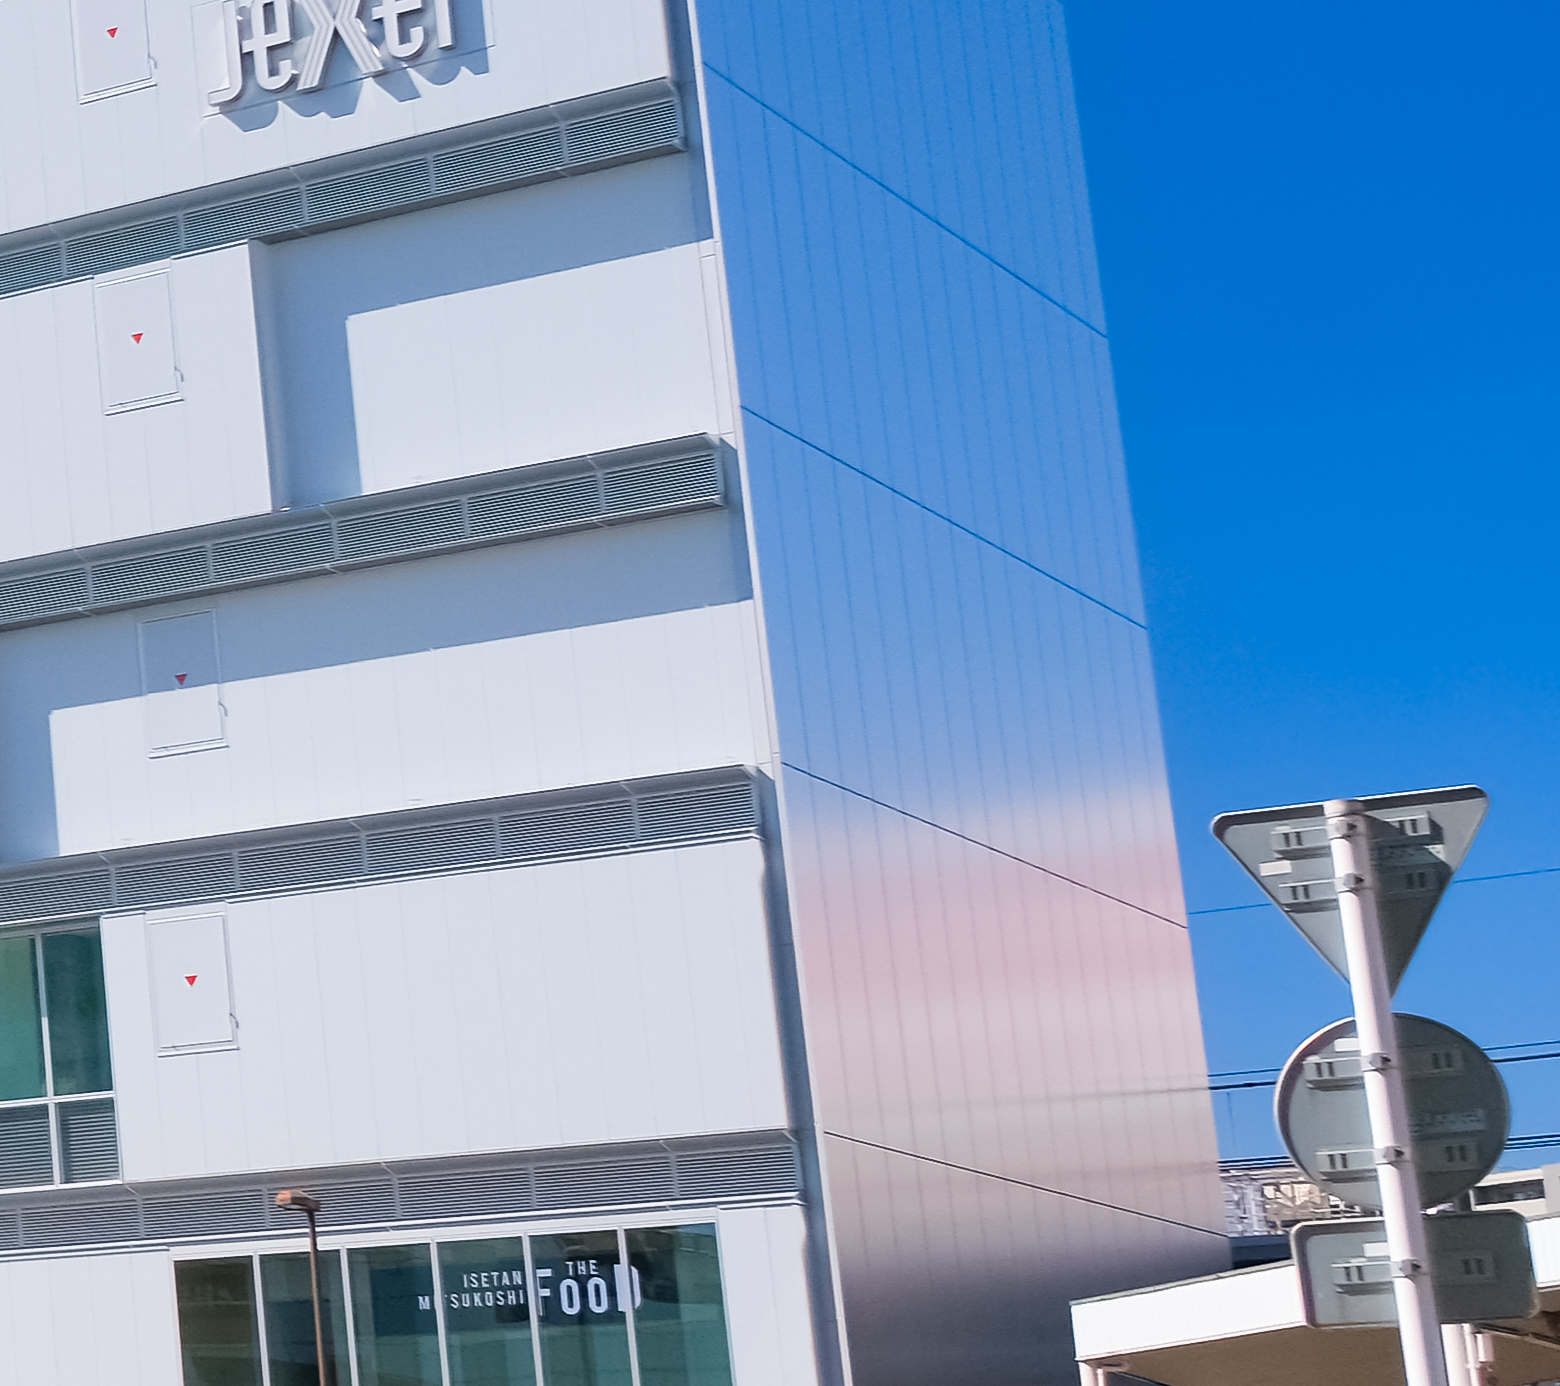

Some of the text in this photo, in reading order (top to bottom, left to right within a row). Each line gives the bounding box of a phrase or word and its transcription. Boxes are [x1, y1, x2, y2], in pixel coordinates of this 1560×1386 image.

[565, 1259, 600, 1277] THE
[463, 1269, 523, 1289] ISETAN
[418, 1289, 525, 1311] MSUKOSHI
[535, 1263, 643, 1317] FOOD
